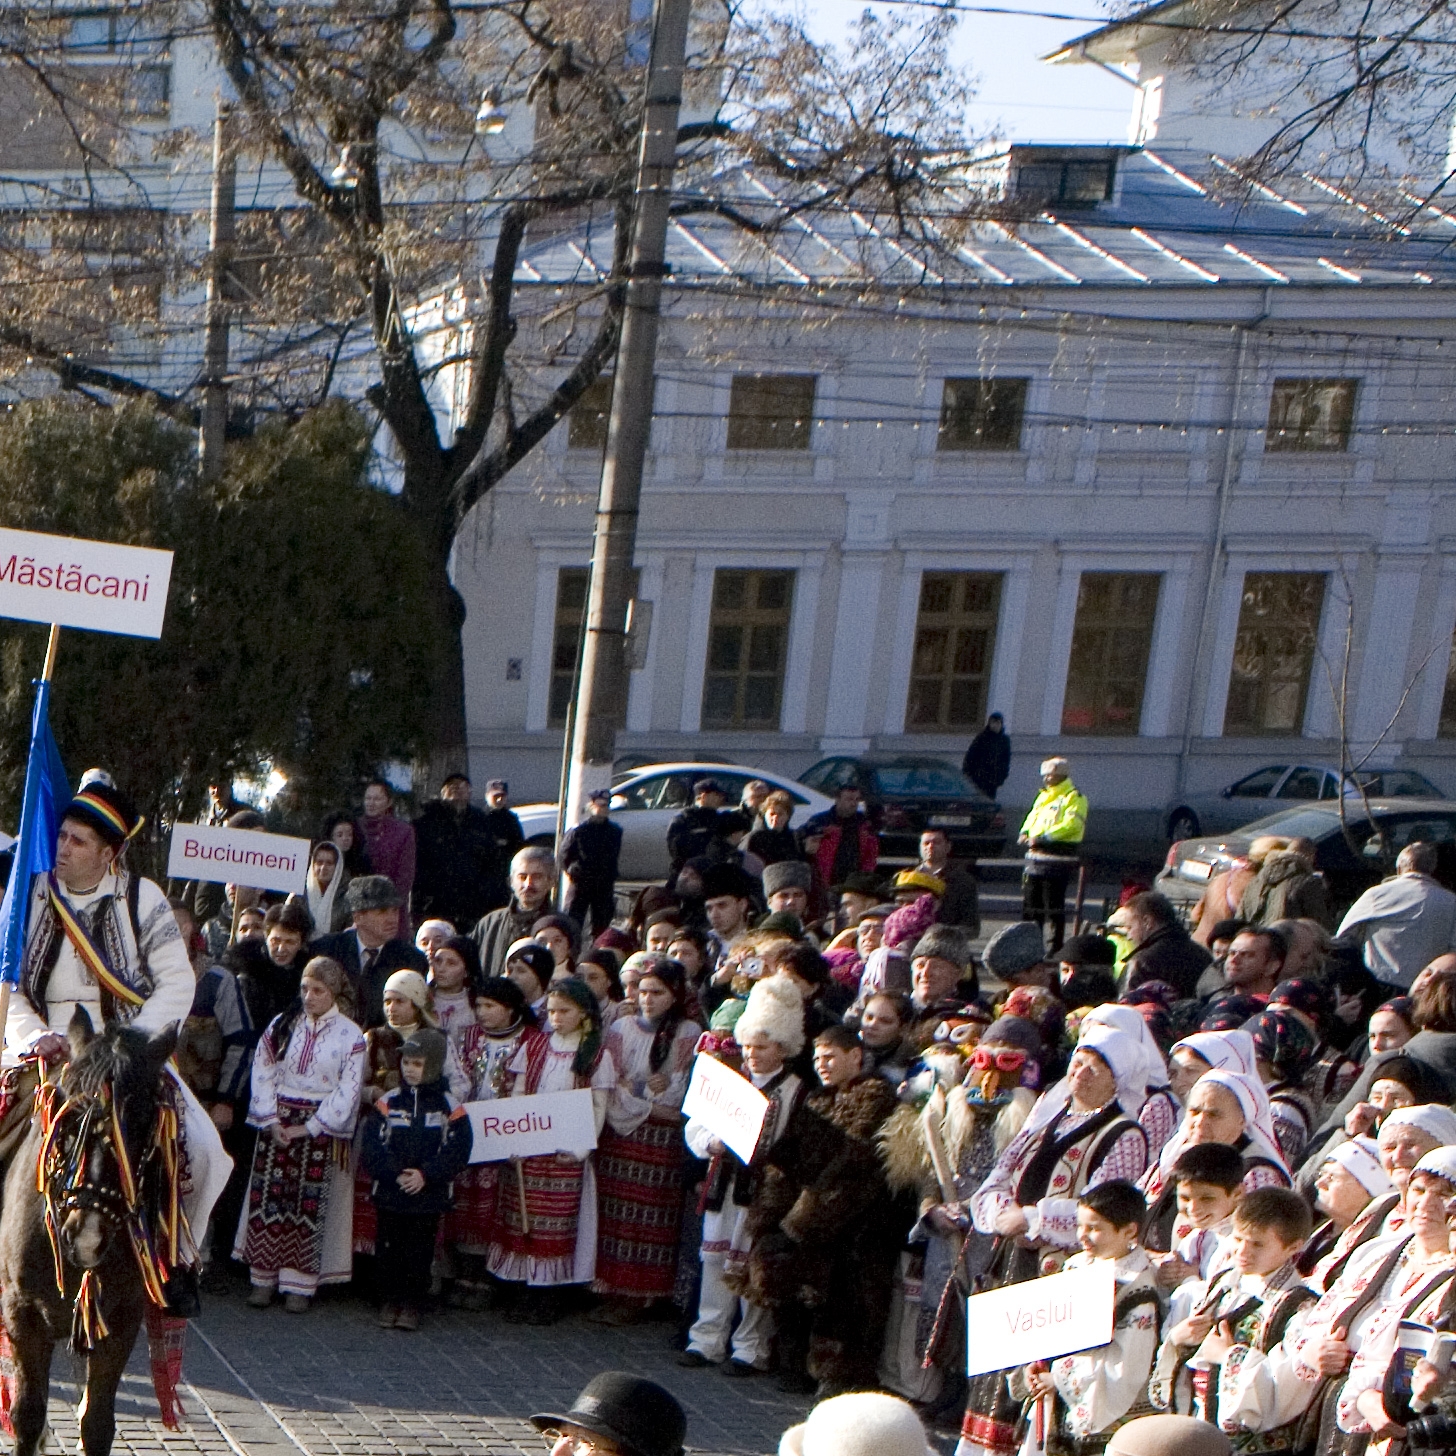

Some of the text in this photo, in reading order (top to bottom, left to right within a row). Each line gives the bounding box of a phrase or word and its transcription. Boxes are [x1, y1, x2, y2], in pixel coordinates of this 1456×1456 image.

[184, 839, 296, 871] Buciumeni
[483, 1112, 552, 1137] Rediu
[1006, 1295, 1072, 1334] Vaslui
